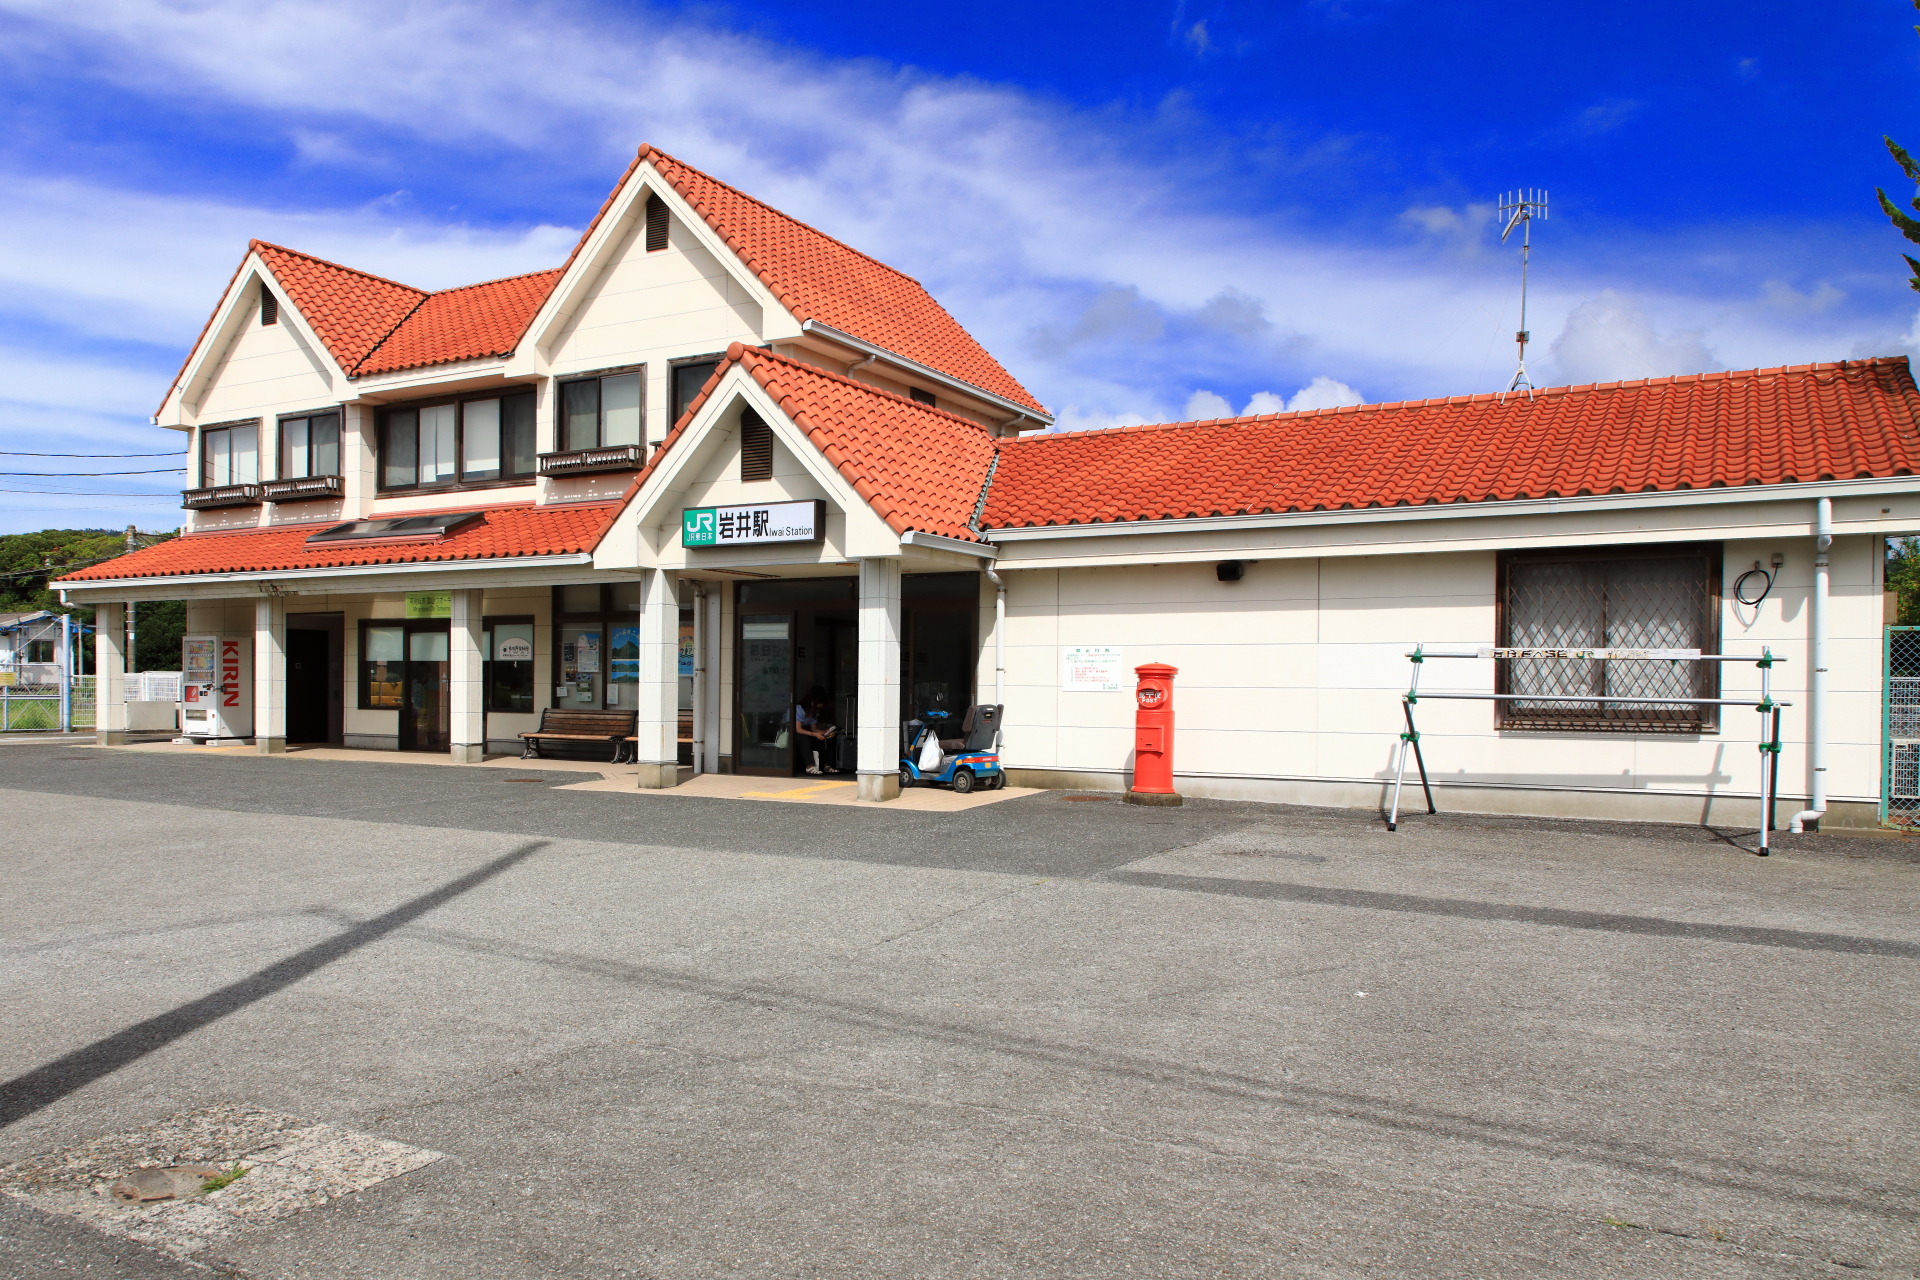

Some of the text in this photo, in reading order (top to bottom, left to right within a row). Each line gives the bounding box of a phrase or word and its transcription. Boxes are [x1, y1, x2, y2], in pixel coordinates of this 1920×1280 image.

[687, 513, 713, 532] JR
[718, 510, 813, 540] 岩井駅 Iwai Station
[686, 532, 713, 542] JR東日本
[223, 641, 239, 707] KIRIN
